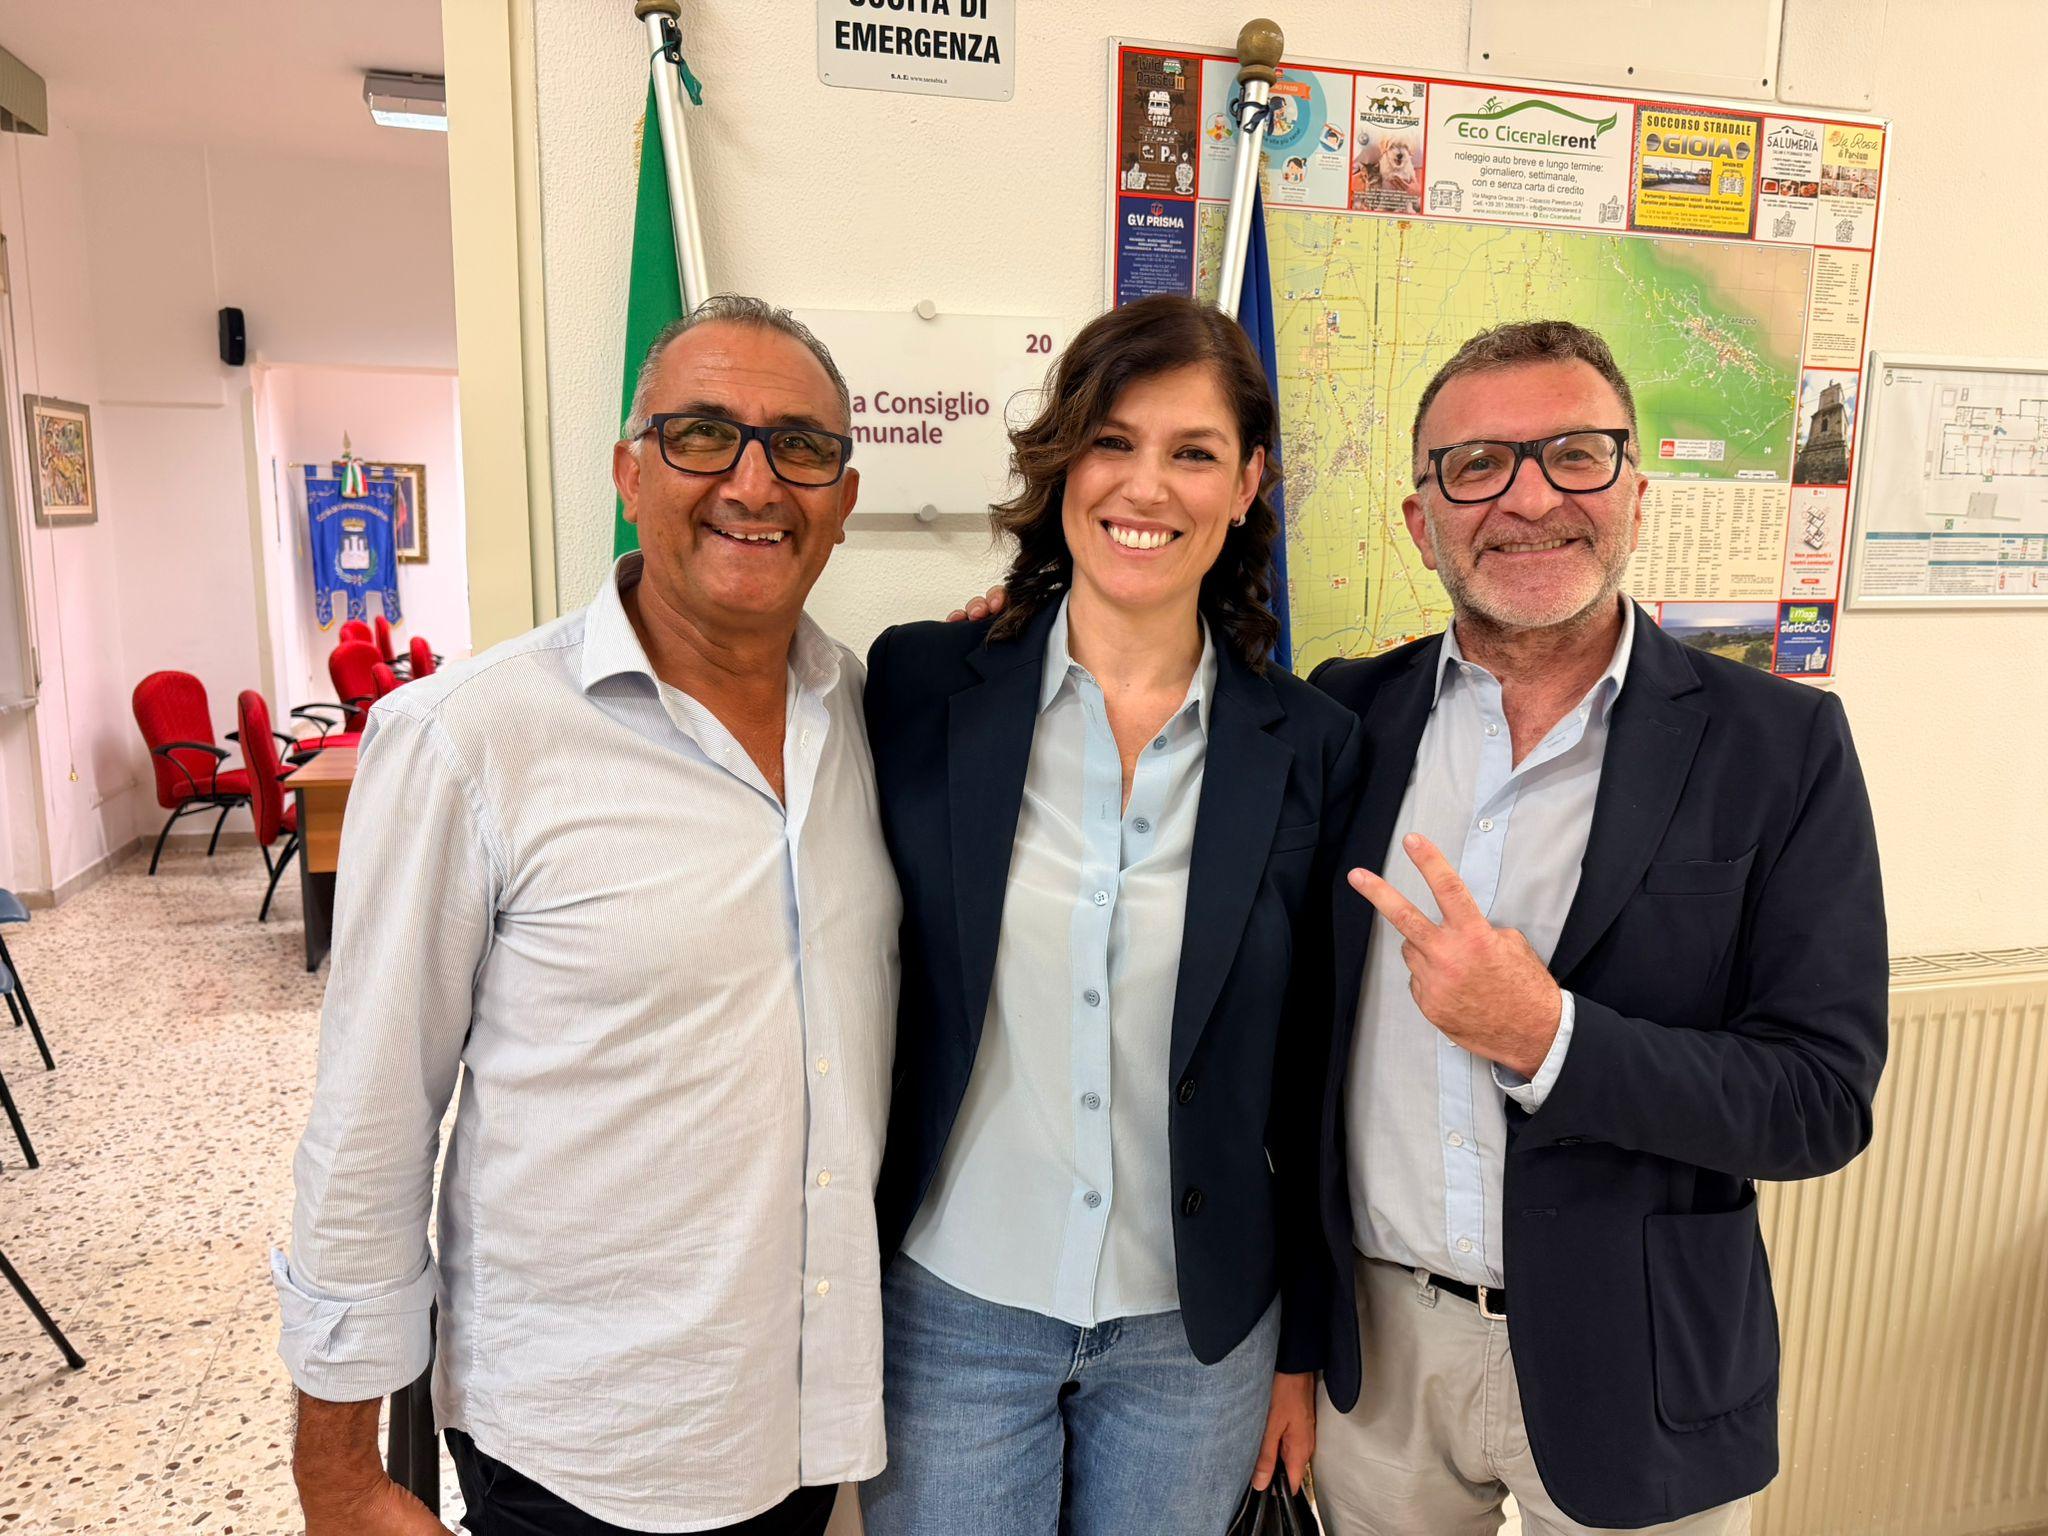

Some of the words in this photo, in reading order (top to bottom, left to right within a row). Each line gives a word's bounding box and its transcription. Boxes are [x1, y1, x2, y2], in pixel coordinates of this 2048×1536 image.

[835, 20, 1000, 64] EMERGENZA
[1647, 115, 1700, 131] SOCCORSO
[1704, 121, 1751, 136] STRADALE
[1458, 122, 1488, 139] Eco
[1496, 125, 1597, 150] Ciceralerent
[1767, 136, 1819, 152] SALUMERIA
[1851, 132, 1879, 150] Rosa
[1161, 146, 1170, 162] P
[1662, 134, 1734, 159] GIOIA
[1454, 152, 1490, 164] noleggio
[1493, 155, 1511, 164] auto
[1513, 157, 1536, 167] breve
[1546, 158, 1568, 171] lungo
[1571, 161, 1603, 173] termine:
[1480, 166, 1526, 179] giornaliero,
[1528, 170, 1577, 183] settimanale,
[1472, 179, 1487, 187] con
[1490, 180, 1495, 188] e
[1497, 181, 1522, 190] senza
[1525, 182, 1545, 192] carta
[1547, 183, 1554, 193] di
[1556, 184, 1584, 195] credito
[1146, 215, 1184, 229] PRISMA
[1025, 334, 1052, 354] 20
[874, 391, 990, 421] Consiglio
[850, 421, 943, 444] munale
